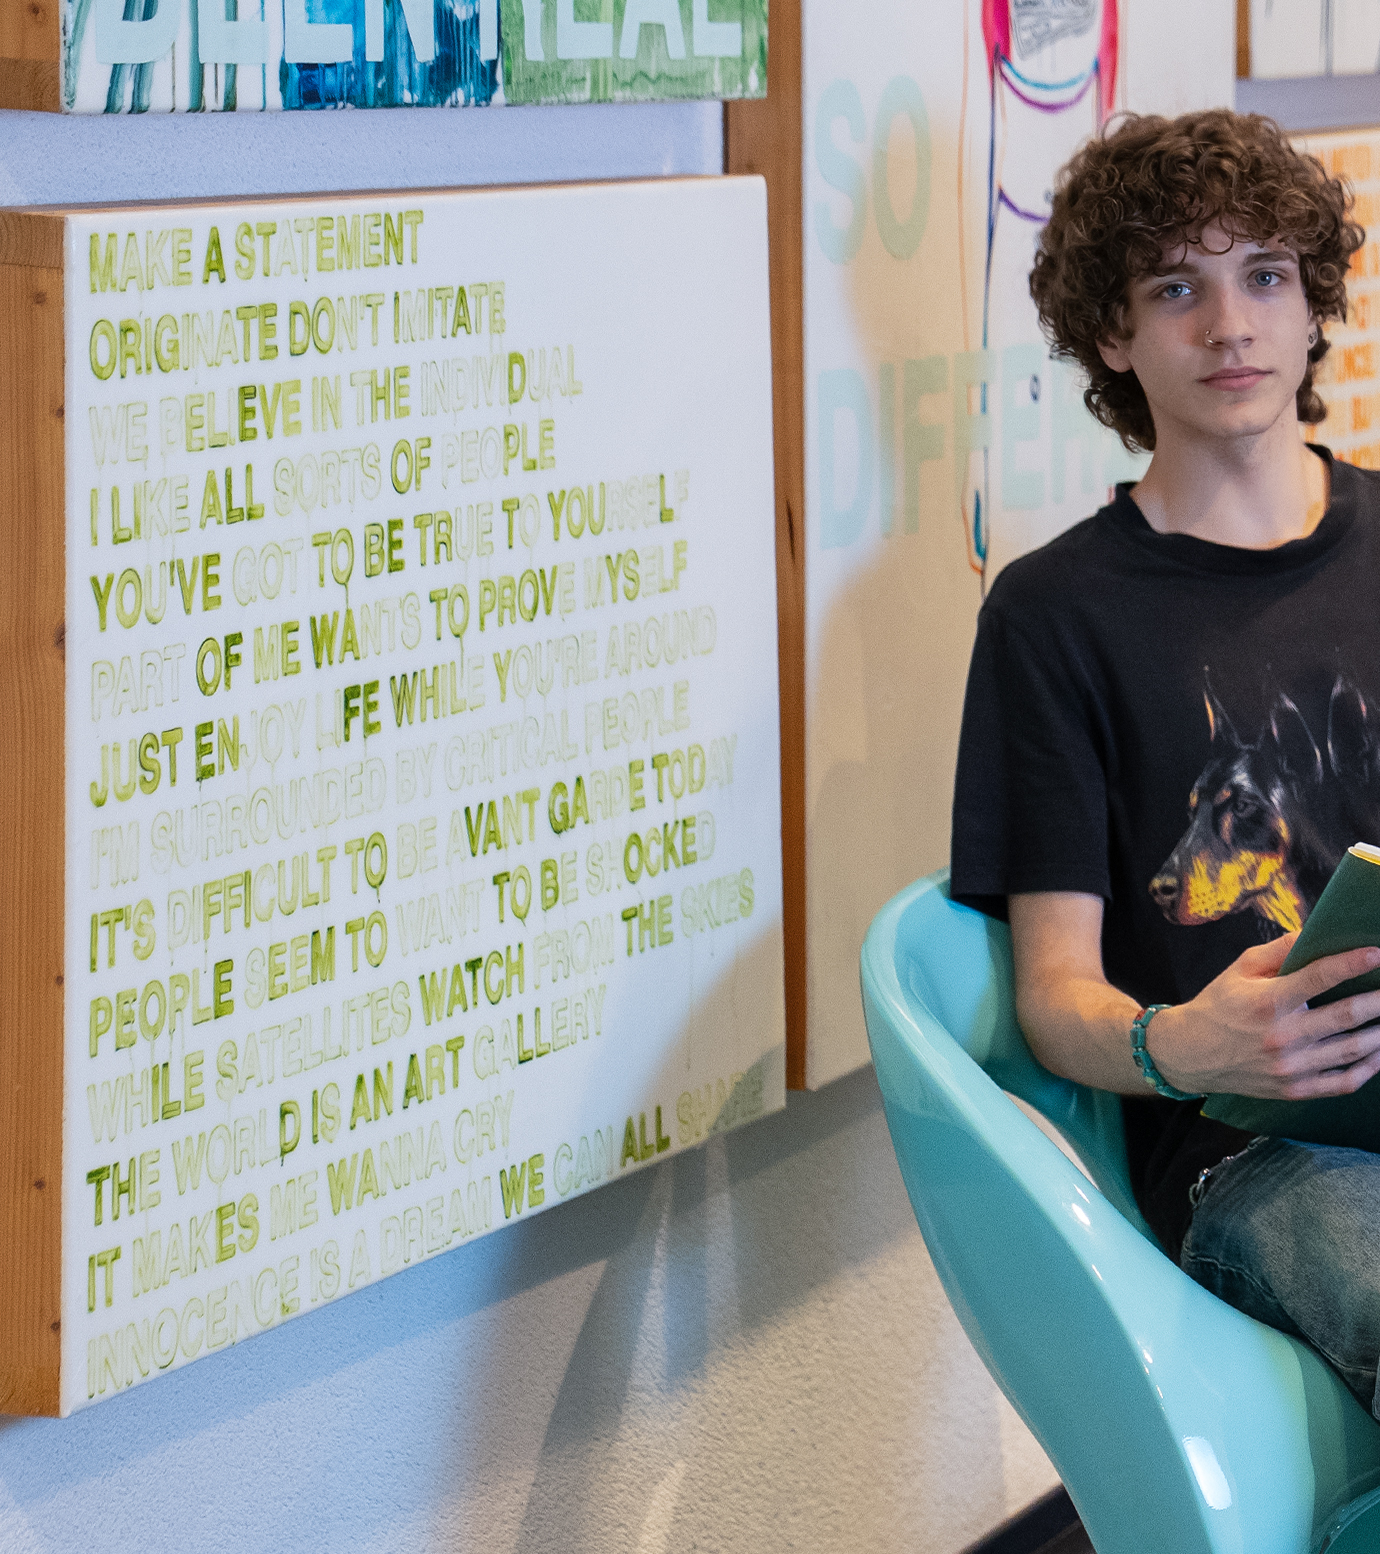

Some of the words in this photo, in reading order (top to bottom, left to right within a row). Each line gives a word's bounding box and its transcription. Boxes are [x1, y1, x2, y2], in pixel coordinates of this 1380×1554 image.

[89, 228, 192, 294] MAKE
[202, 226, 226, 283] A
[235, 210, 424, 281] STATEMENT
[815, 75, 932, 265] SO
[88, 401, 148, 467] WE
[159, 379, 302, 455] BELIEVE
[311, 375, 342, 432] IN
[350, 365, 411, 425] THE
[420, 344, 583, 416] INDIVIDUAL
[89, 303, 278, 380] ORIGINATE
[290, 293, 385, 356] DON'T
[393, 281, 506, 344] IMITATE
[89, 487, 99, 547] I
[110, 474, 190, 545] LIKE
[199, 462, 265, 530] ALL
[273, 442, 382, 517] SORTS
[390, 436, 432, 495] OF
[441, 418, 556, 489] PEOPLE
[89, 551, 222, 632] YOU'VE
[232, 537, 304, 607] GOT
[311, 527, 355, 588] TO
[364, 517, 405, 579] BE
[413, 501, 494, 567] TRUE
[501, 493, 541, 549] TO
[547, 469, 690, 541] YOURSELF
[89, 726, 184, 808] JUST
[194, 698, 307, 784] ENJOY
[316, 679, 382, 752] LIFE
[389, 655, 486, 728] WHILE
[493, 629, 599, 703] YOU'RE
[603, 605, 717, 681] AROUND
[91, 642, 186, 723] PART
[195, 630, 243, 697] OF
[253, 619, 301, 685] ME
[308, 591, 421, 670] WANTS
[429, 583, 470, 641] TO
[478, 562, 576, 633] PROVE
[584, 539, 689, 611] MYSELF
[89, 898, 156, 973] IT'S
[168, 845, 338, 952] DIFFICULT
[344, 830, 388, 894] TO
[396, 816, 438, 880] BE
[446, 787, 541, 866] AVANT
[547, 758, 646, 835] GARDE
[651, 734, 737, 803] TODAY
[150, 757, 387, 875] SURROUNDED
[396, 742, 438, 804] BY
[444, 709, 578, 792] CRITICAL
[584, 679, 690, 756] PEOPLE
[87, 1050, 205, 1143] WHILE
[215, 979, 412, 1103] SATELLITES
[418, 942, 525, 1026] WATCH
[532, 913, 615, 990] FROM
[620, 894, 674, 957] THE
[681, 868, 755, 939] SKIES
[89, 957, 235, 1058] PEOPLE
[244, 925, 336, 1009] SEEM
[344, 909, 388, 973] TO
[395, 878, 484, 958] WANT
[492, 864, 532, 924] TO
[540, 850, 579, 911] BE
[585, 809, 716, 897] SHOCKED
[86, 1149, 161, 1227] THE
[172, 1099, 300, 1195] WORLD
[312, 1081, 341, 1144] IS
[349, 1060, 394, 1131] AN
[402, 1034, 465, 1110] ART
[473, 983, 606, 1080] GALLERY
[87, 1246, 122, 1313] IT
[132, 1193, 259, 1298] MAKES
[269, 1170, 318, 1241] ME
[327, 1120, 446, 1217] WANNA
[454, 1090, 515, 1165] CRY
[87, 1255, 300, 1399] INNOCENCE
[310, 1240, 341, 1303] IS
[348, 1228, 372, 1289] A
[379, 1176, 491, 1275] DREAM
[499, 1153, 545, 1219] WE
[553, 1126, 613, 1196] CAN
[620, 1104, 671, 1167] ALL
